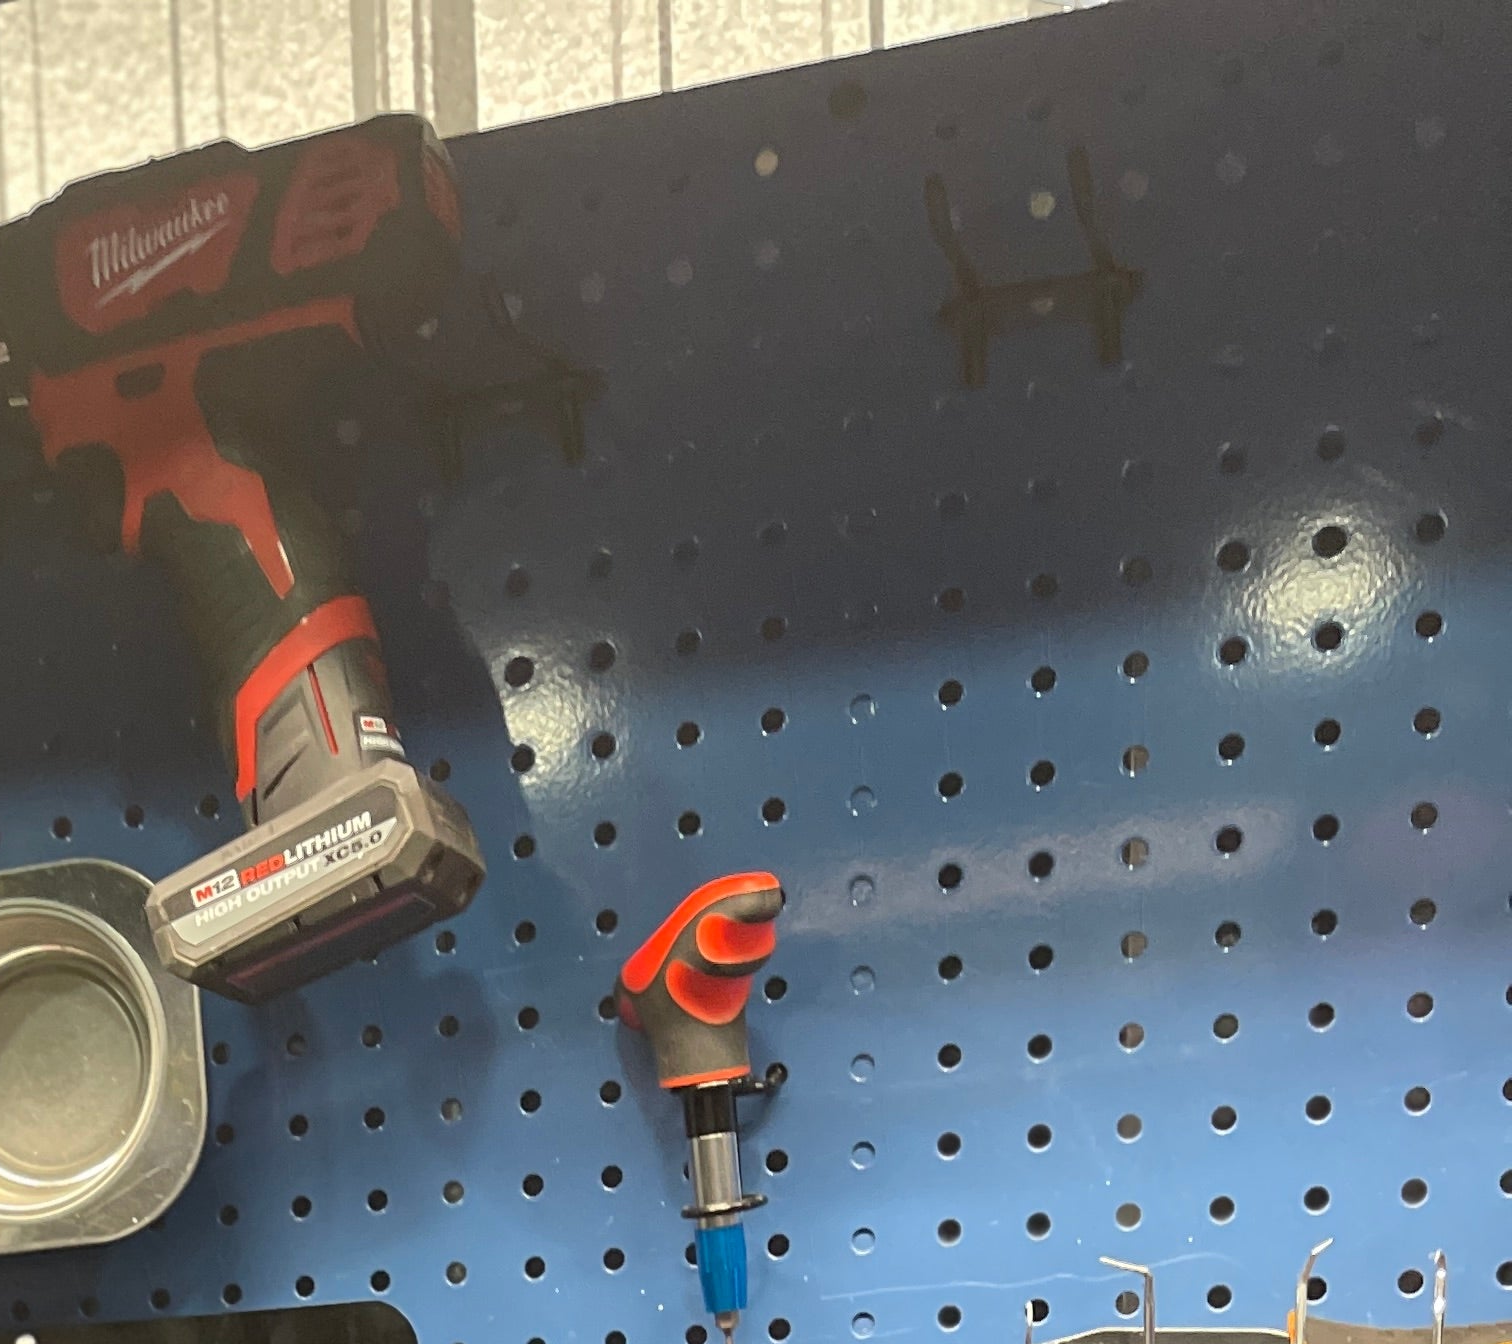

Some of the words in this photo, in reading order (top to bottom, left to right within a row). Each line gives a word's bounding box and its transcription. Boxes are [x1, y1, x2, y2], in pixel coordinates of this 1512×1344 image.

[88, 191, 230, 289] Milwaukee
[194, 895, 243, 927] HIGH
[245, 857, 321, 902] OUTPUT
[323, 829, 382, 867] XC5.0
[194, 874, 236, 903] M12
